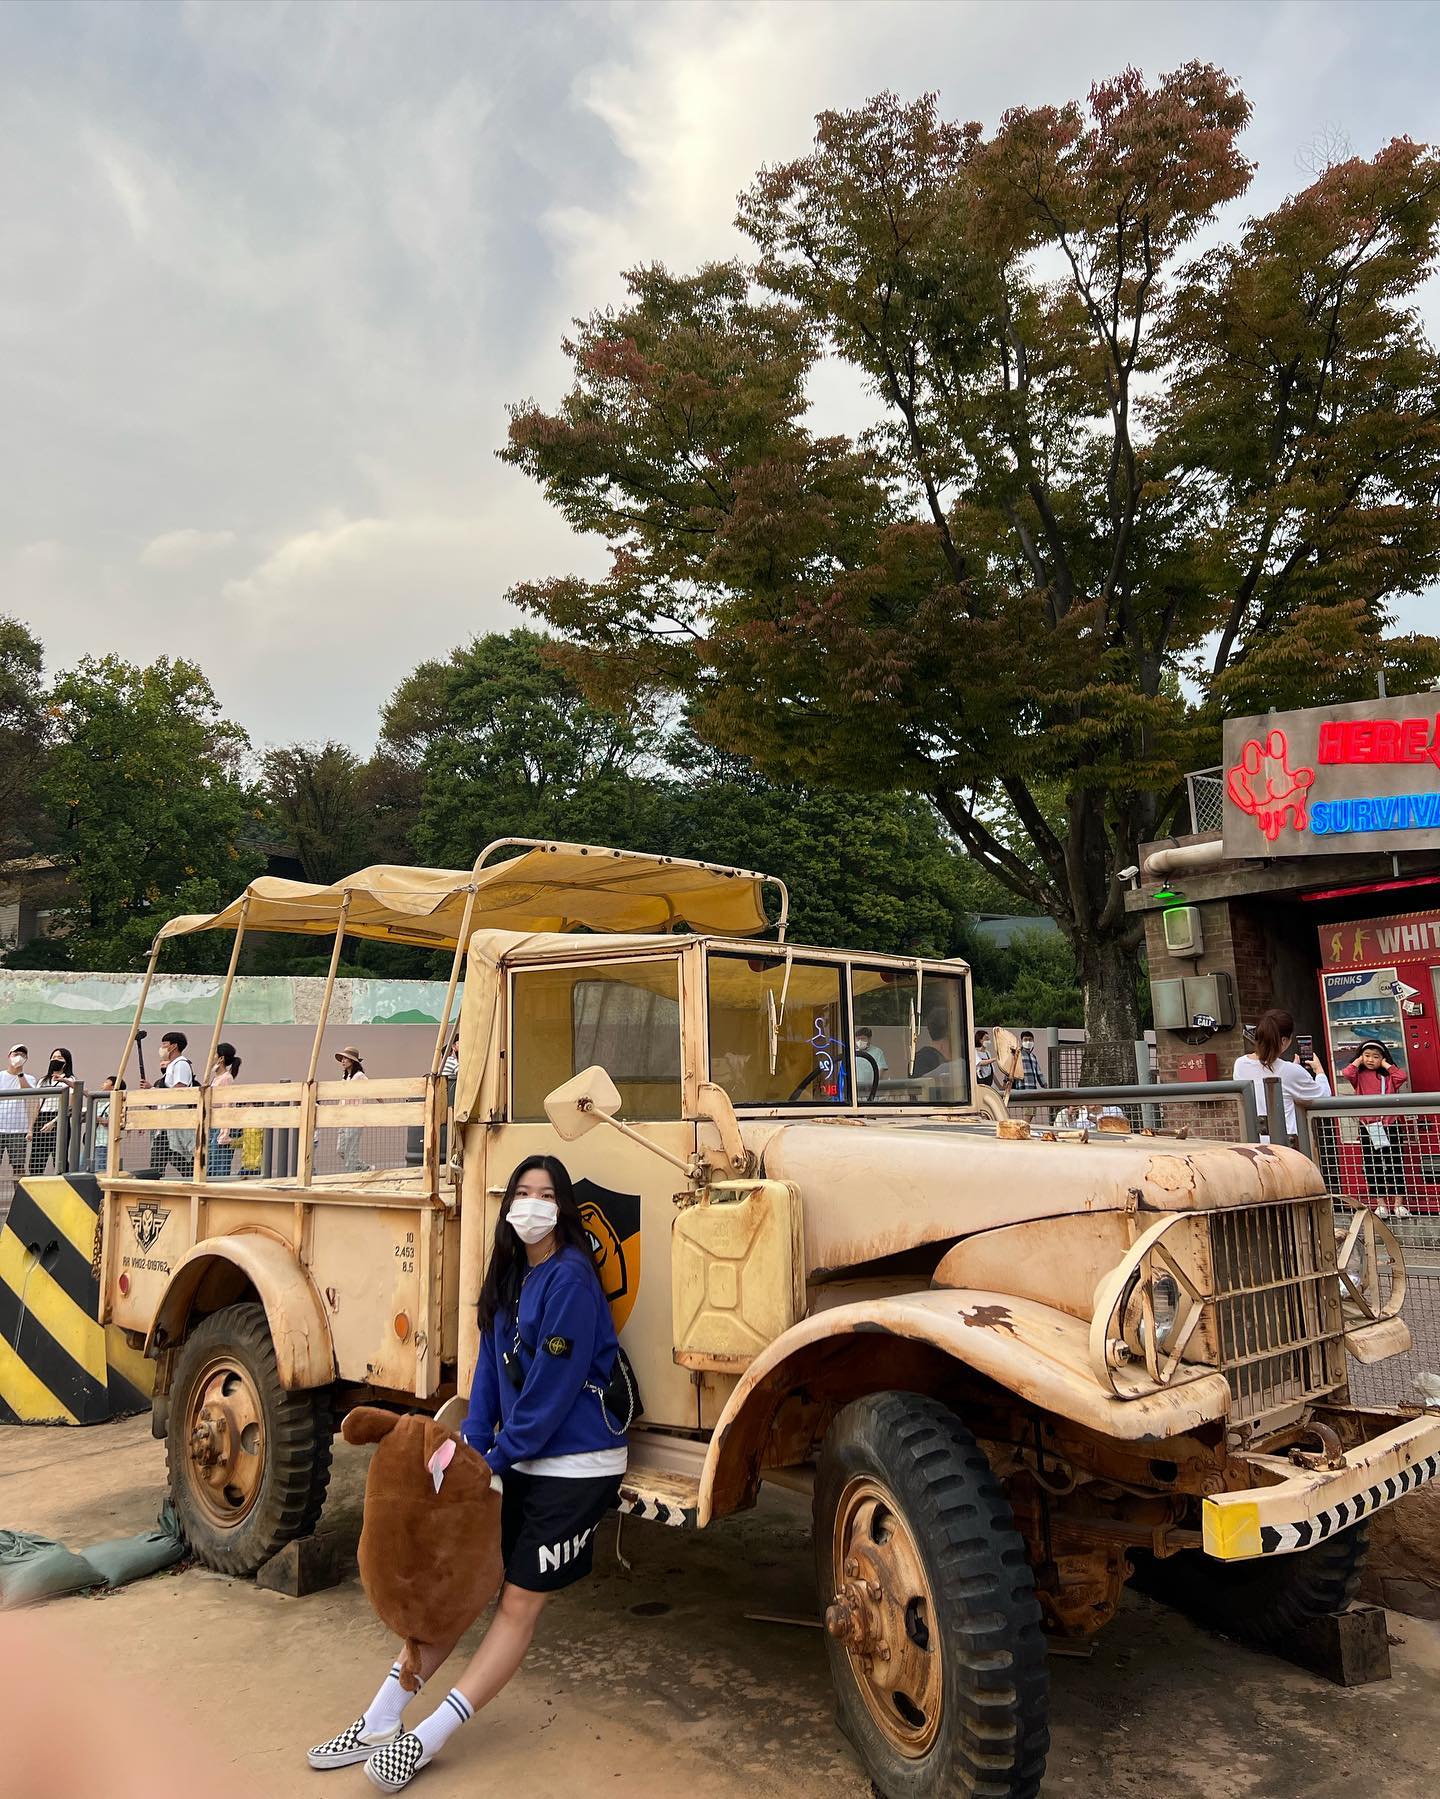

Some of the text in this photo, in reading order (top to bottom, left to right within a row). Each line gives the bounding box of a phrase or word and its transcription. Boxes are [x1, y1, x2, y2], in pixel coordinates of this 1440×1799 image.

[1327, 975, 1363, 987] DRINKS
[406, 1232, 414, 1243] 10
[395, 1246, 415, 1258] 2,453
[402, 1261, 414, 1273] 8.5
[539, 1520, 600, 1574] NIK
